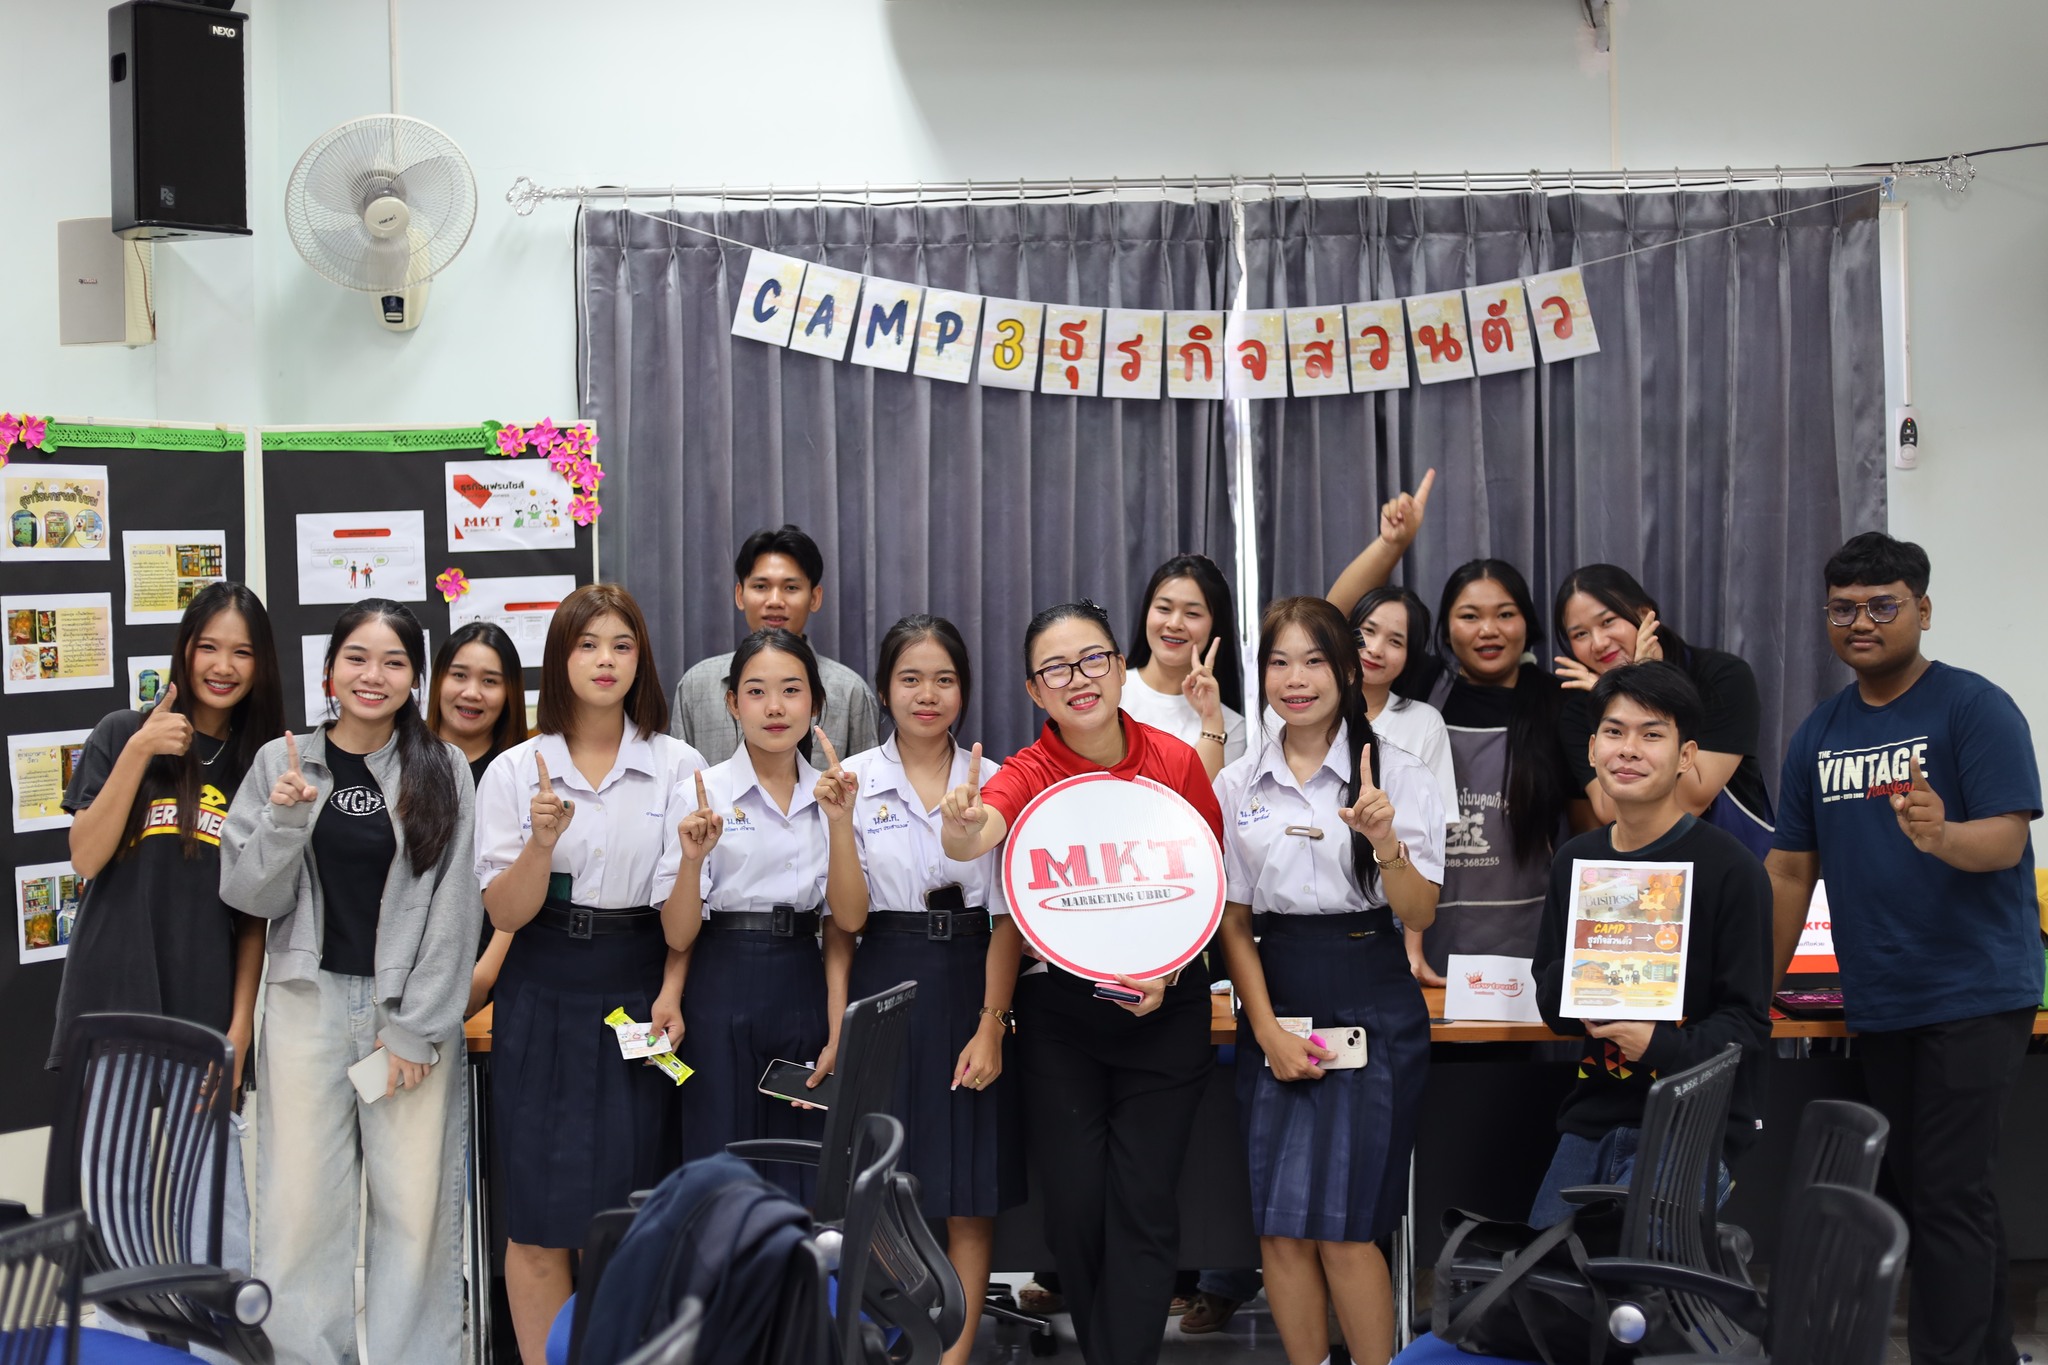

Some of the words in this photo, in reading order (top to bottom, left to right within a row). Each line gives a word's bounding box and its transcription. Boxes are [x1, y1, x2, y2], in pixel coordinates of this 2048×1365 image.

[212, 25, 236, 38] NEXO
[752, 277, 964, 358] CAMP
[463, 516, 503, 528] MKT
[1818, 750, 1832, 759] THE
[1818, 743, 1928, 794] VINTAGE
[1028, 839, 1198, 890] MKT
[1061, 892, 1134, 908] MARKETING
[1137, 888, 1172, 901] UBRU
[1584, 893, 1636, 907] Business
[1593, 923, 1625, 934] CAMP
